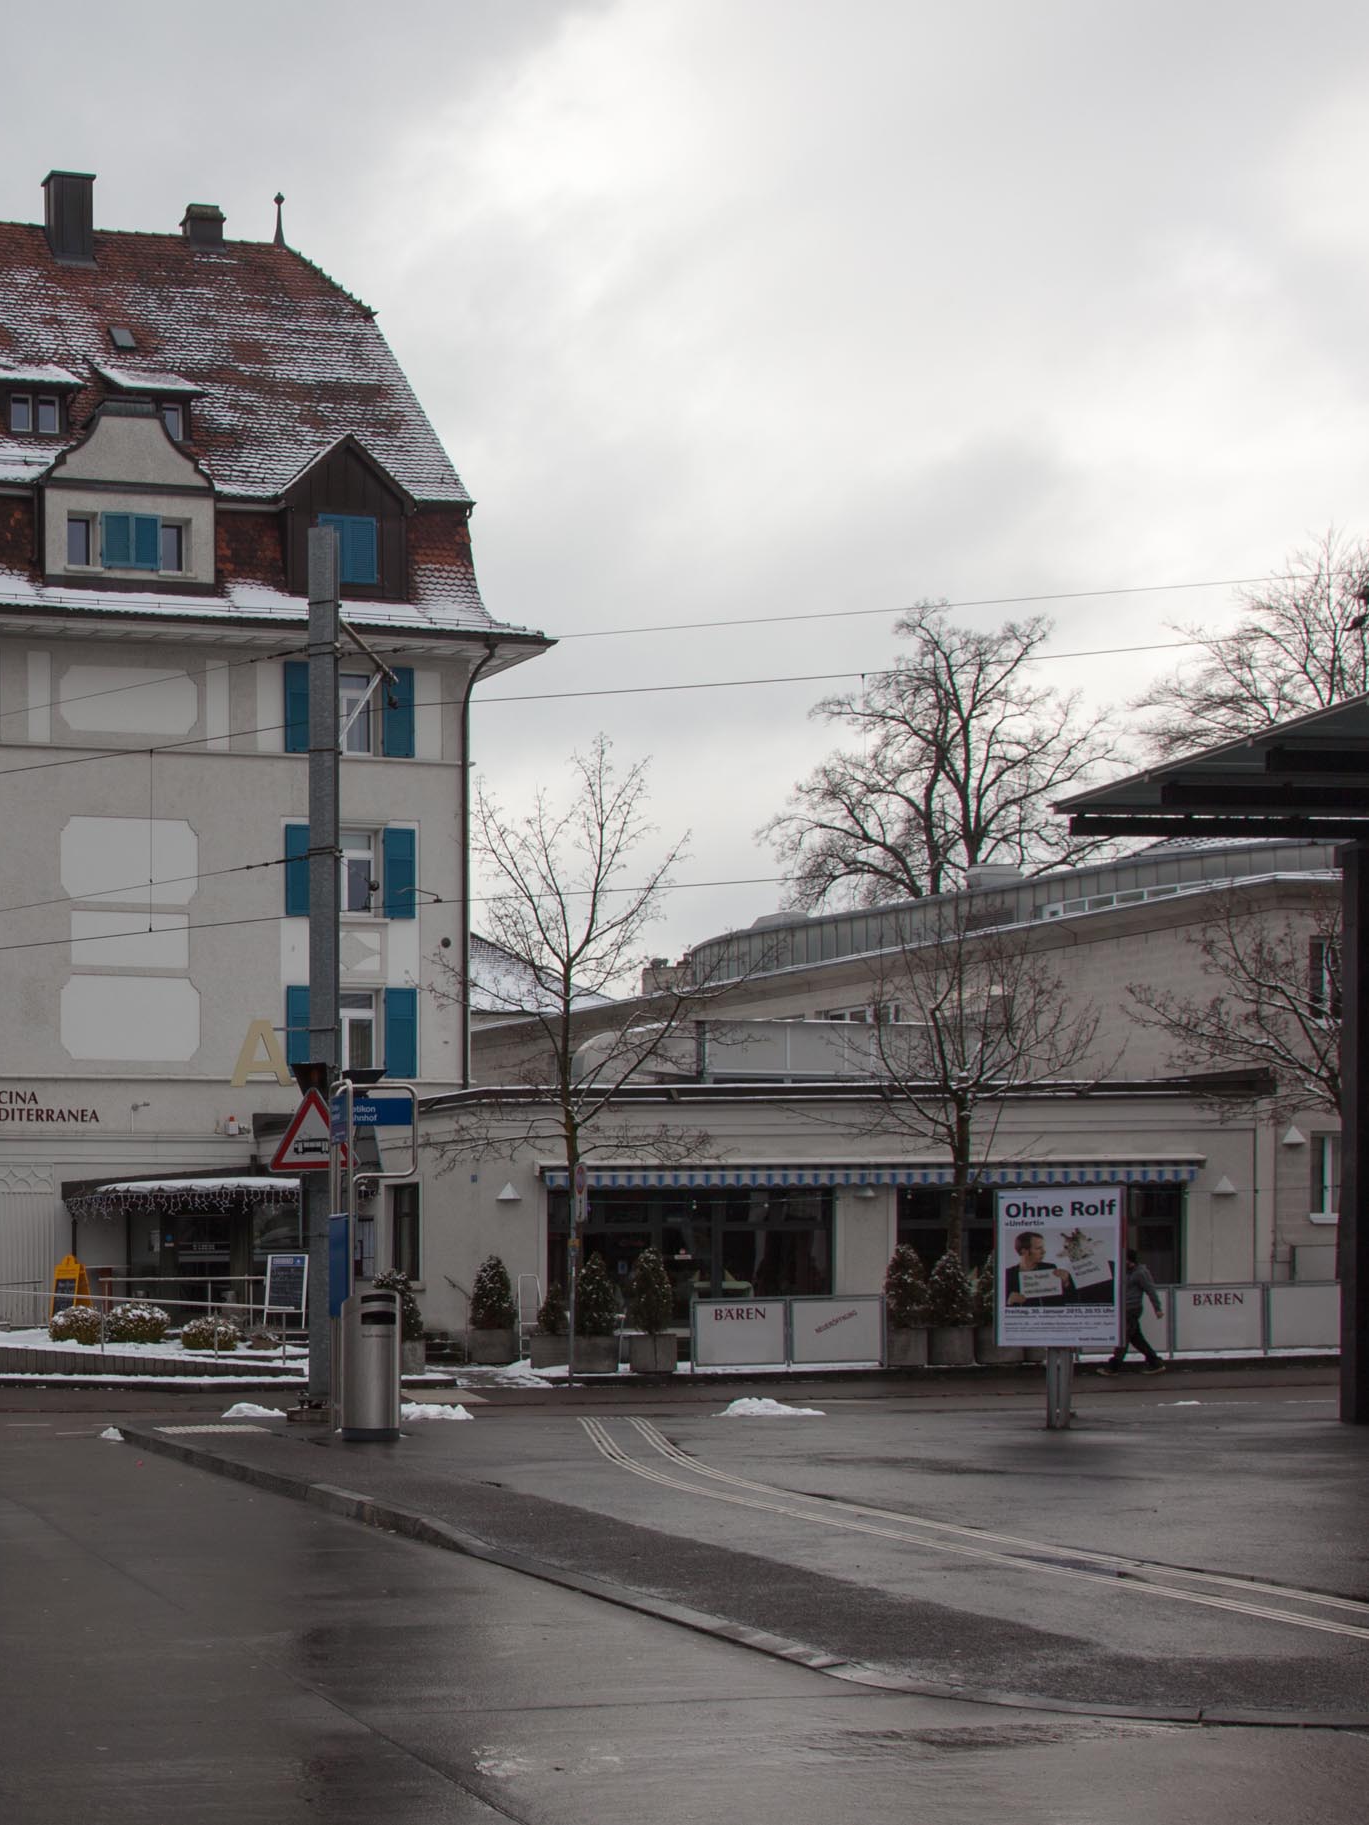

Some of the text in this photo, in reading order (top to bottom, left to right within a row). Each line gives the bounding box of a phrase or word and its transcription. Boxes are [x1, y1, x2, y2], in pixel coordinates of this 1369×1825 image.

[230, 1019, 294, 1087] A
[1005, 1199, 1117, 1218] Ohne Rolf
[1192, 1292, 1244, 1306] BÄREN
[714, 1307, 766, 1321] BÄREN
